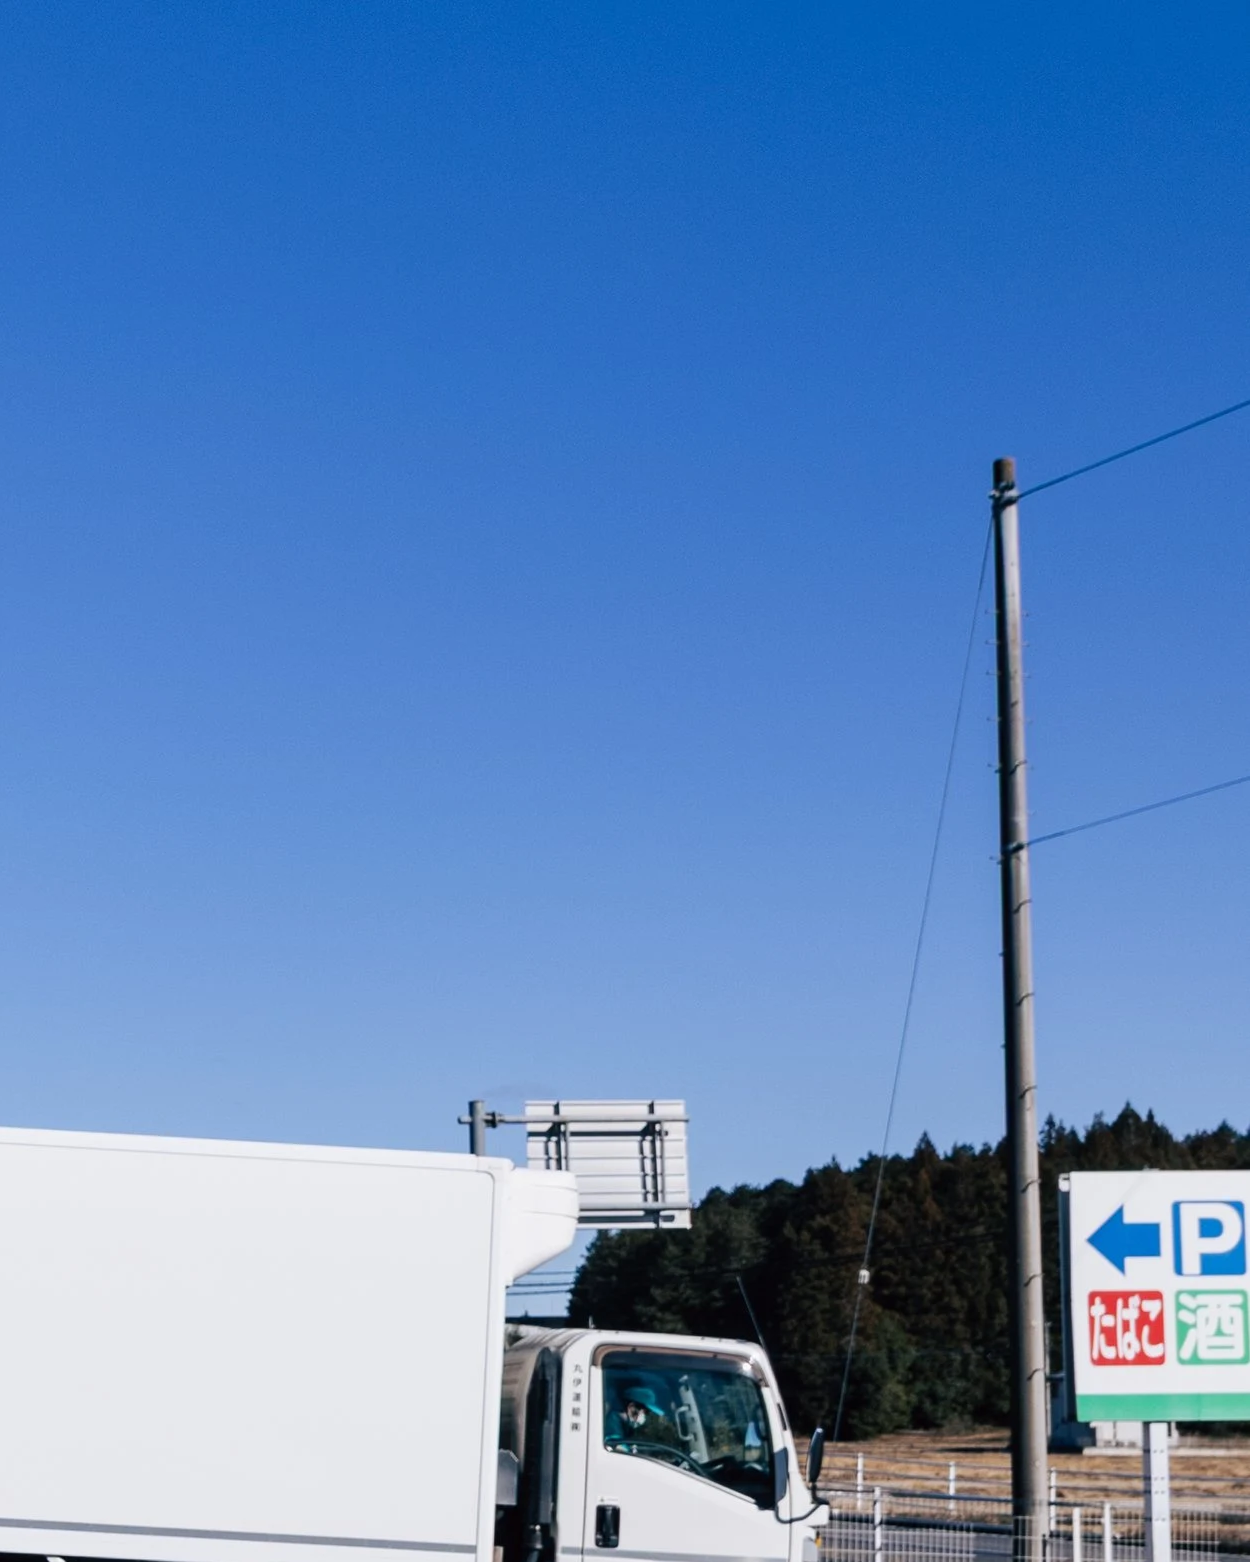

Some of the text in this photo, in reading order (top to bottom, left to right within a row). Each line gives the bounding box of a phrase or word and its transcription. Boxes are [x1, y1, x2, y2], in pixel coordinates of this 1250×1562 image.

[1180, 1202, 1243, 1275] P
[1090, 1294, 1164, 1360] たばこ
[1177, 1293, 1244, 1360] 酒
